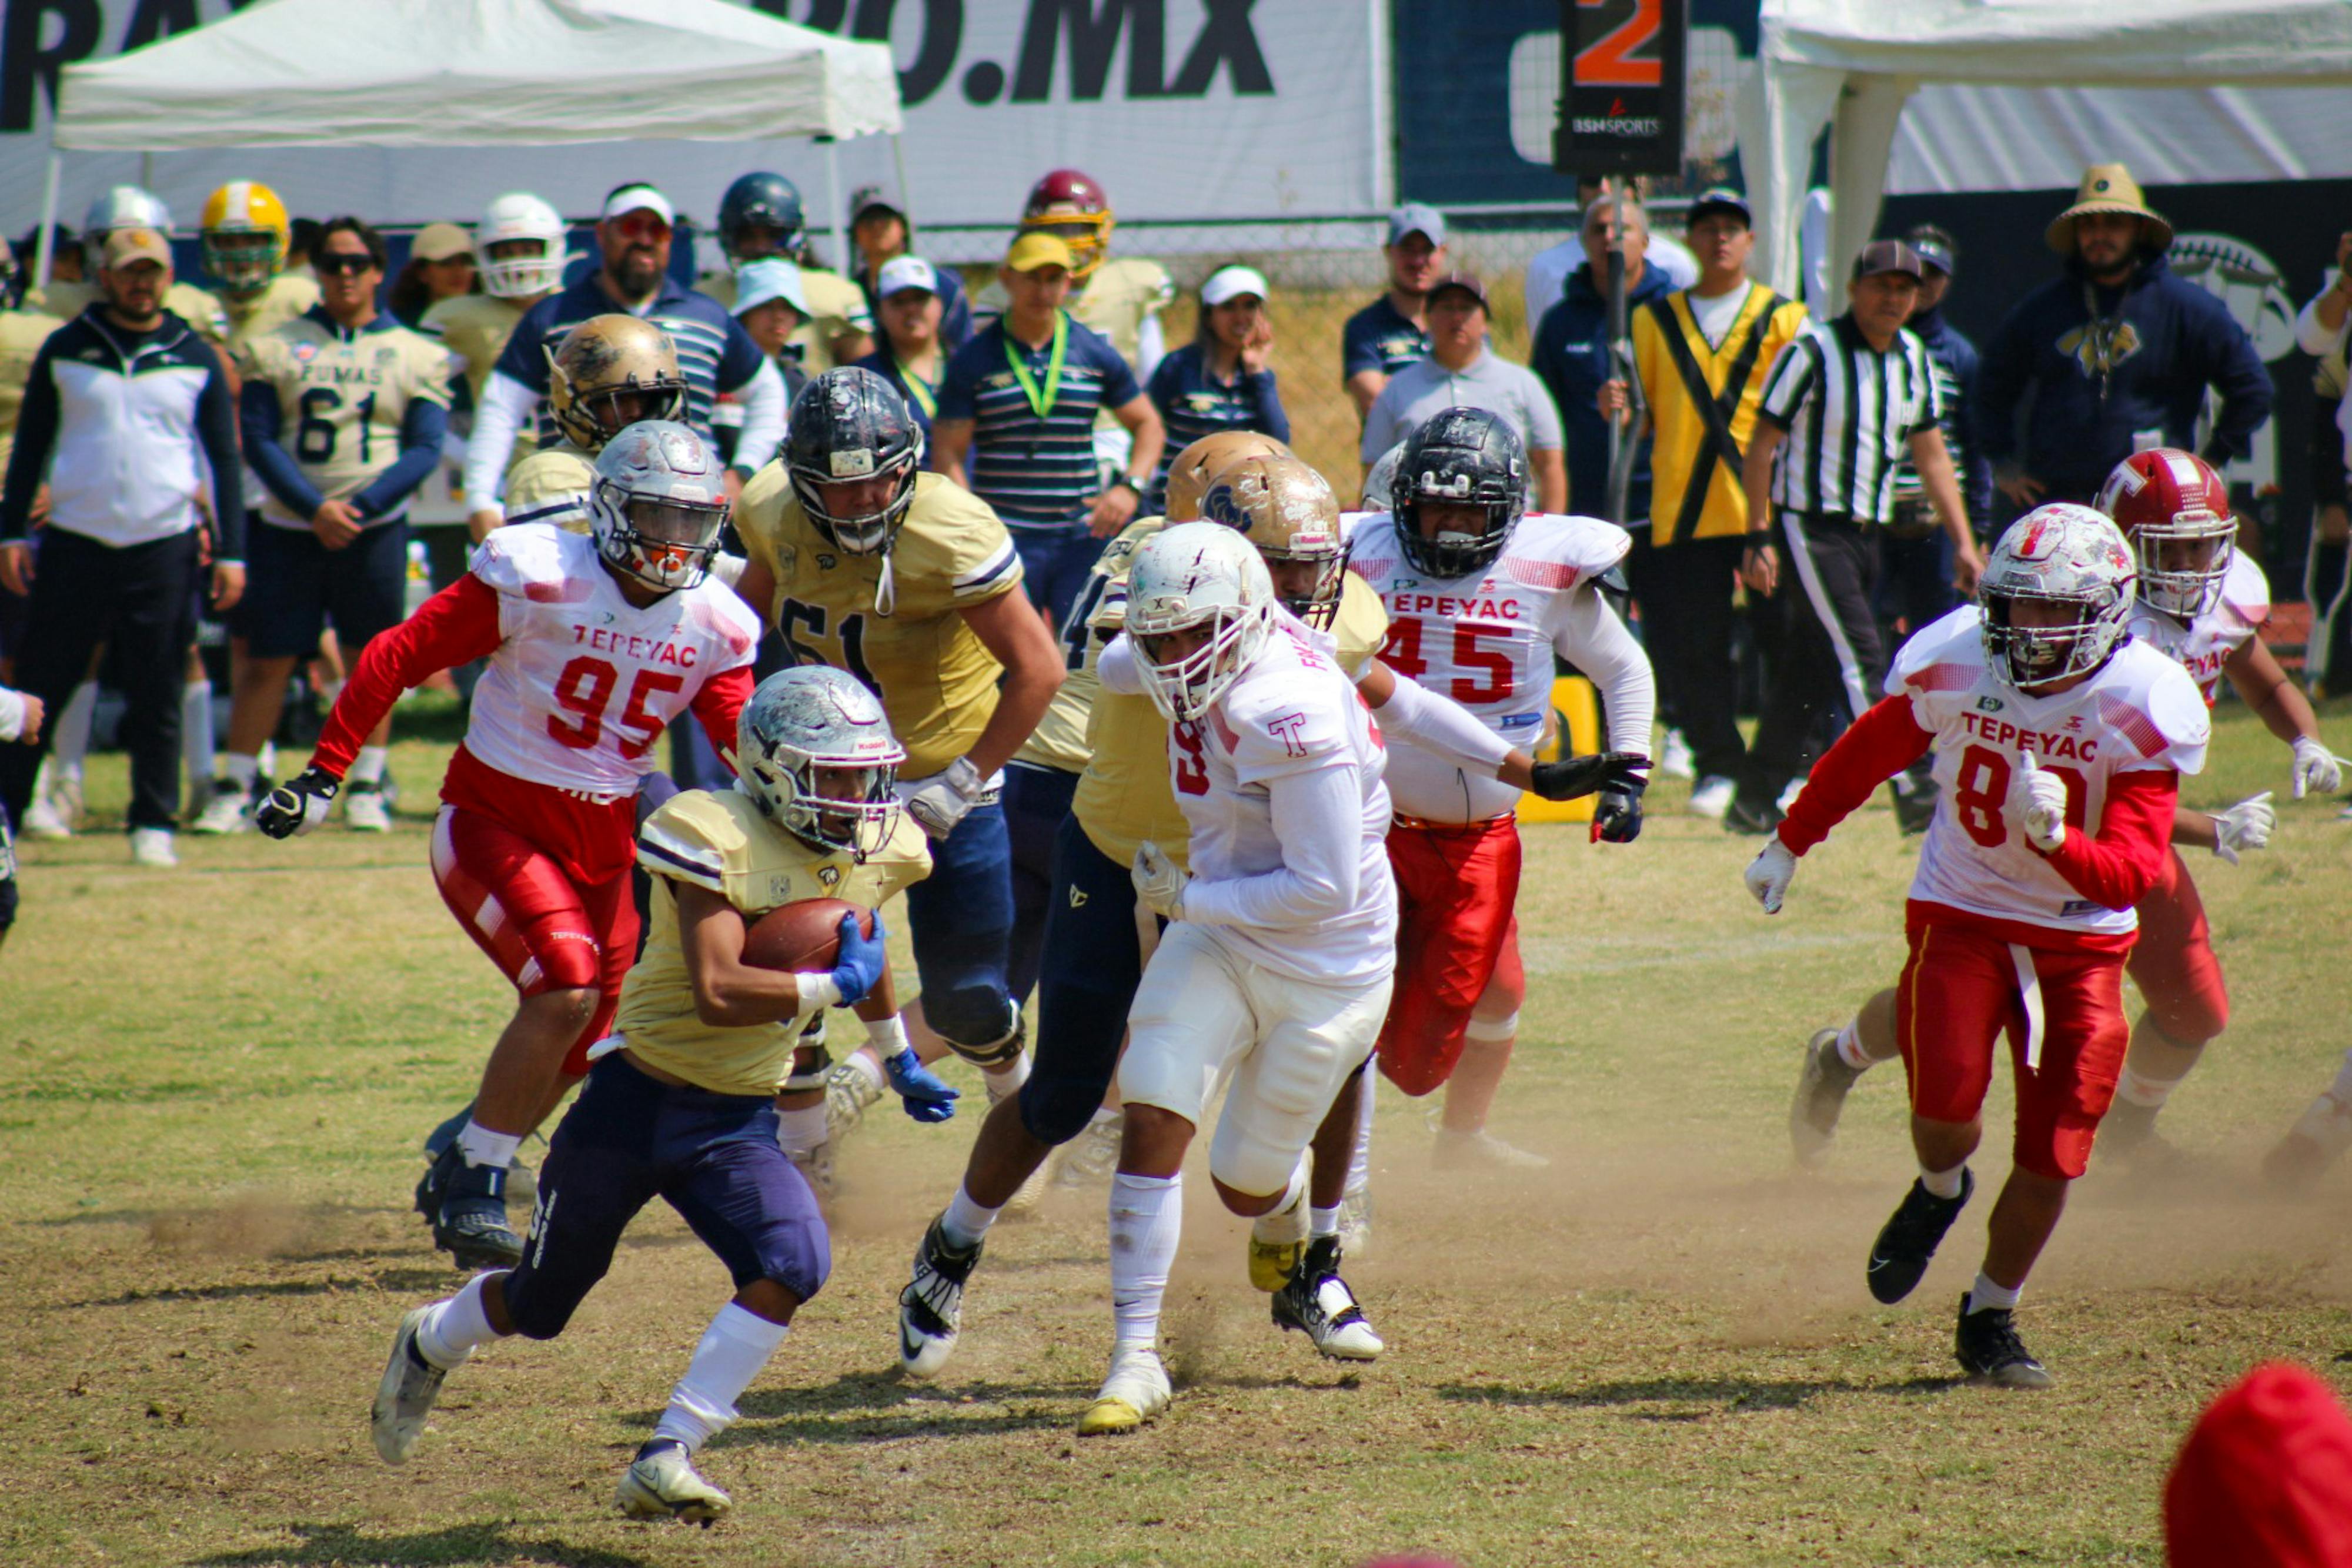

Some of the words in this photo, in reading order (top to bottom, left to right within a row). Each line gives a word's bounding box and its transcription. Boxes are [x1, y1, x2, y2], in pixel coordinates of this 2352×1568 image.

[1573, 0, 1662, 86] 2
[300, 365, 384, 385] PUMAS
[296, 388, 377, 464] 61
[573, 624, 697, 668] TEPEYAC
[1374, 617, 1514, 704] 45
[547, 654, 684, 761] 95
[1268, 712, 1308, 758] T
[1961, 711, 2098, 763] TEPEYAC
